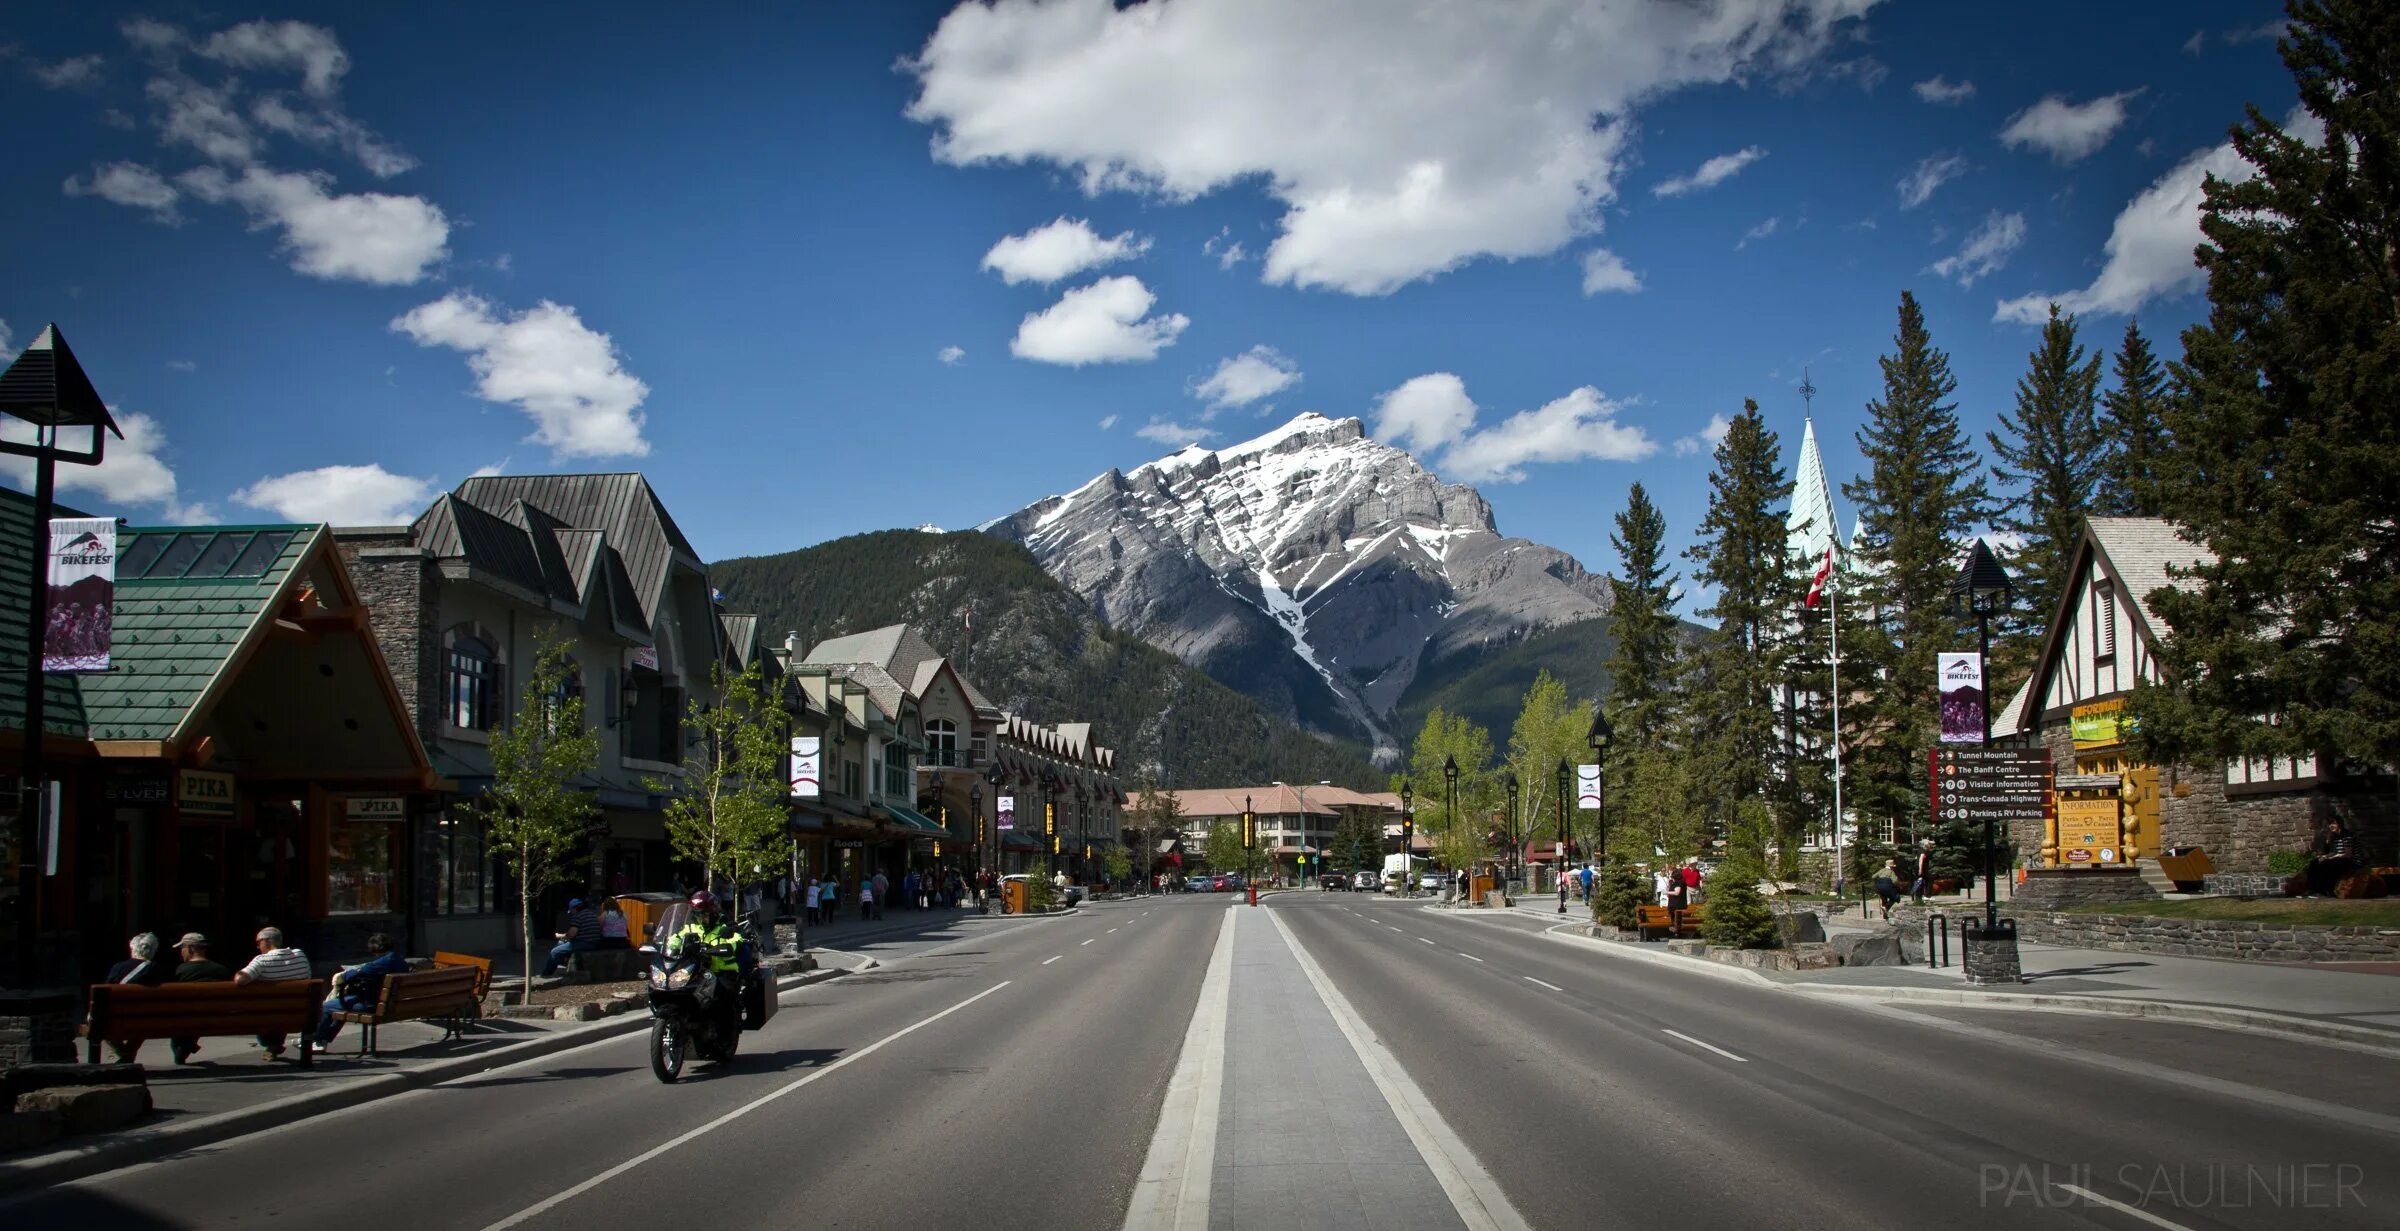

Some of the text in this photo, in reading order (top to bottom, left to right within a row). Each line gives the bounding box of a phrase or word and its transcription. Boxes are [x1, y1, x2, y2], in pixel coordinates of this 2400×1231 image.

[61, 555, 113, 565] BIKEFEST
[1984, 751, 2018, 759] Mountain
[1958, 766, 1972, 774] The
[186, 776, 228, 798] PIKA
[1959, 795, 2042, 803] Trans-Canada Highway
[362, 801, 400, 811] PIKA
[2062, 801, 2114, 810] INFORMATION
[1970, 810, 1997, 818] Parking
[833, 840, 863, 848] Roots
